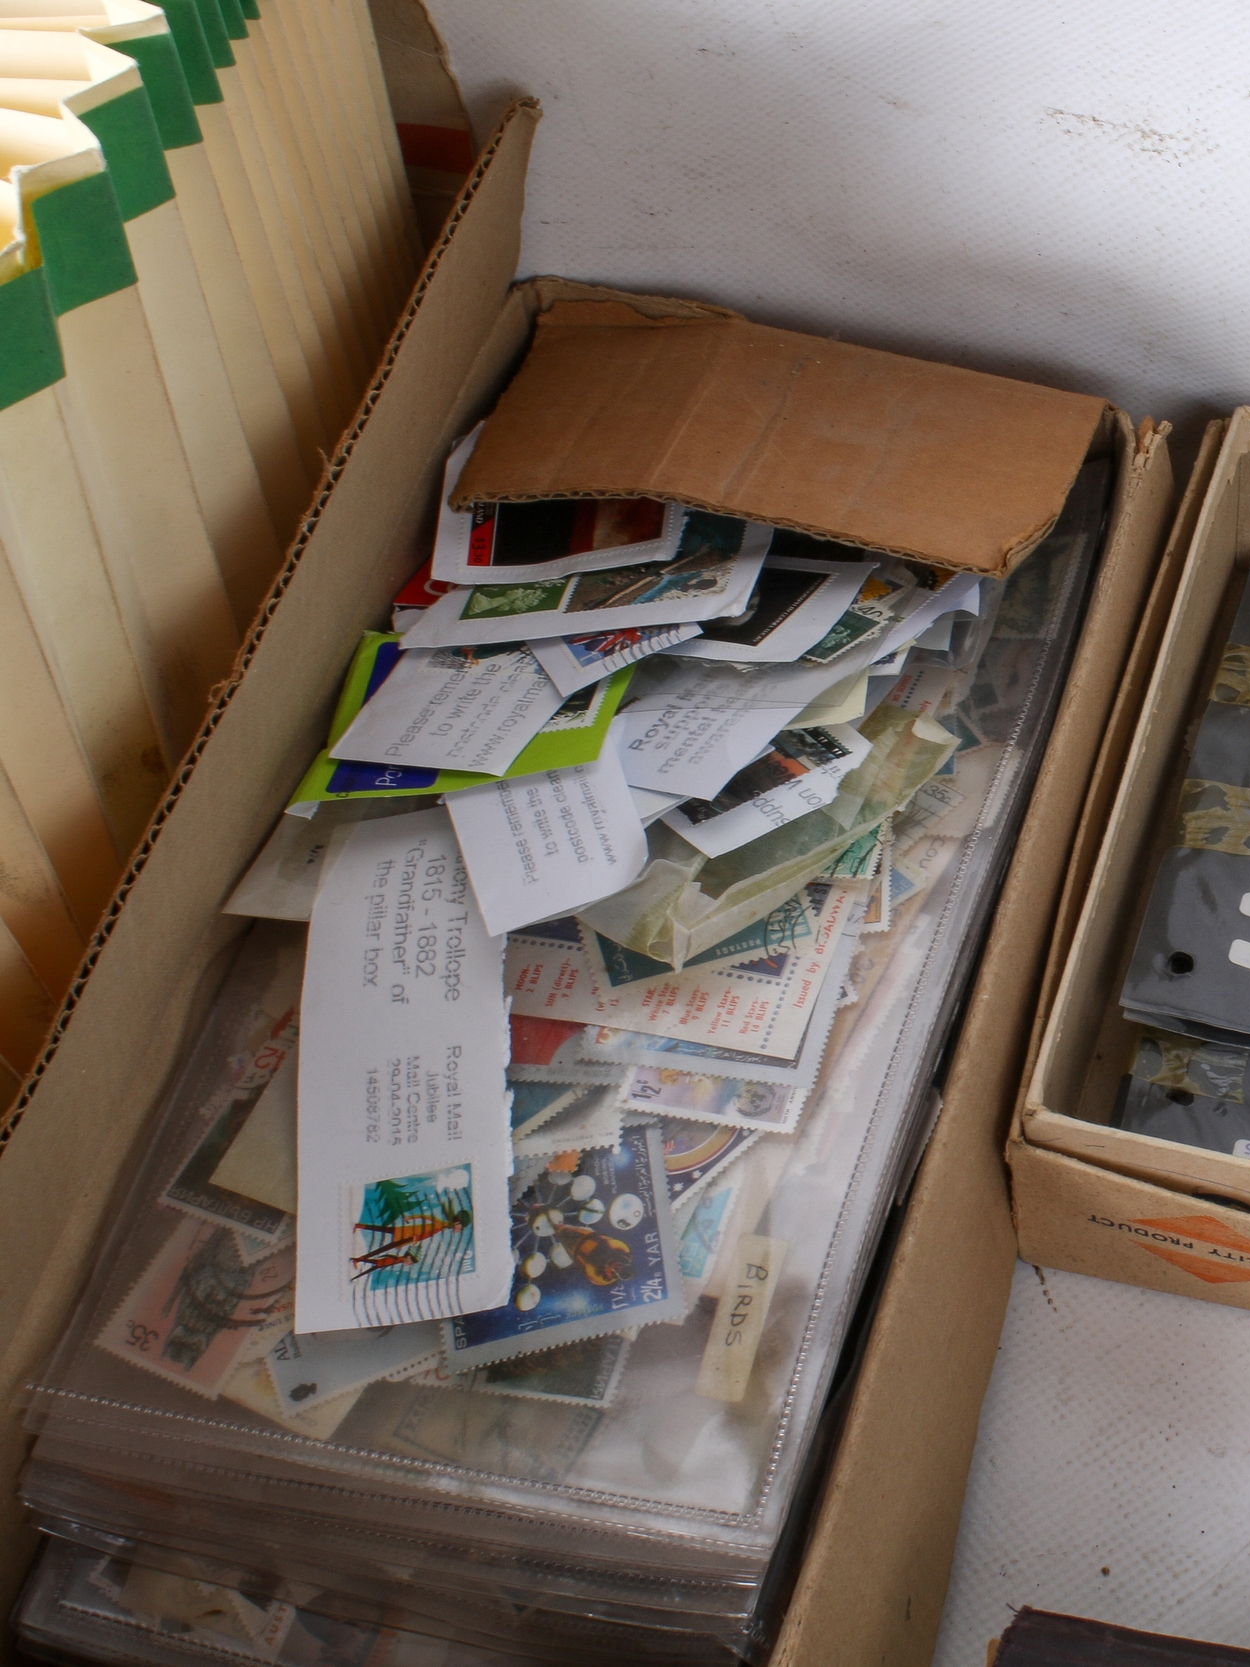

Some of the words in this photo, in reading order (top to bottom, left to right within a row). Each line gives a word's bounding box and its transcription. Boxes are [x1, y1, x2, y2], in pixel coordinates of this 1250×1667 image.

[428, 720, 456, 740] to
[449, 689, 482, 722] write
[475, 662, 503, 692] the
[628, 703, 680, 753] Royal
[656, 714, 717, 775] mental
[525, 786, 544, 808] the
[373, 859, 396, 889] the
[421, 854, 447, 901] 1815
[365, 894, 389, 941] pillar
[415, 922, 438, 978] 1882
[439, 911, 468, 1001] Trollope
[529, 963, 545, 985] BLIPS
[564, 968, 579, 991] BLIPS
[391, 984, 409, 1004] of
[648, 1001, 664, 1023] White
[666, 985, 680, 1007] BLIPS
[695, 991, 711, 1013] BLIPS
[724, 994, 740, 1019] BLIPS
[755, 999, 770, 1024] BLIPS
[793, 979, 813, 1009] Issued
[679, 1009, 692, 1026] Blue
[706, 1012, 723, 1035] Yellow
[738, 1018, 751, 1036] Red
[406, 1054, 420, 1091] Mail
[446, 1045, 462, 1098] Royal
[426, 1069, 439, 1123] Jubilee
[406, 1093, 420, 1144] Centre
[448, 1102, 462, 1141] Mail
[644, 1231, 661, 1268] YAR
[1086, 1213, 1195, 1250] PRODUCT
[725, 1262, 769, 1348] BIRDS
